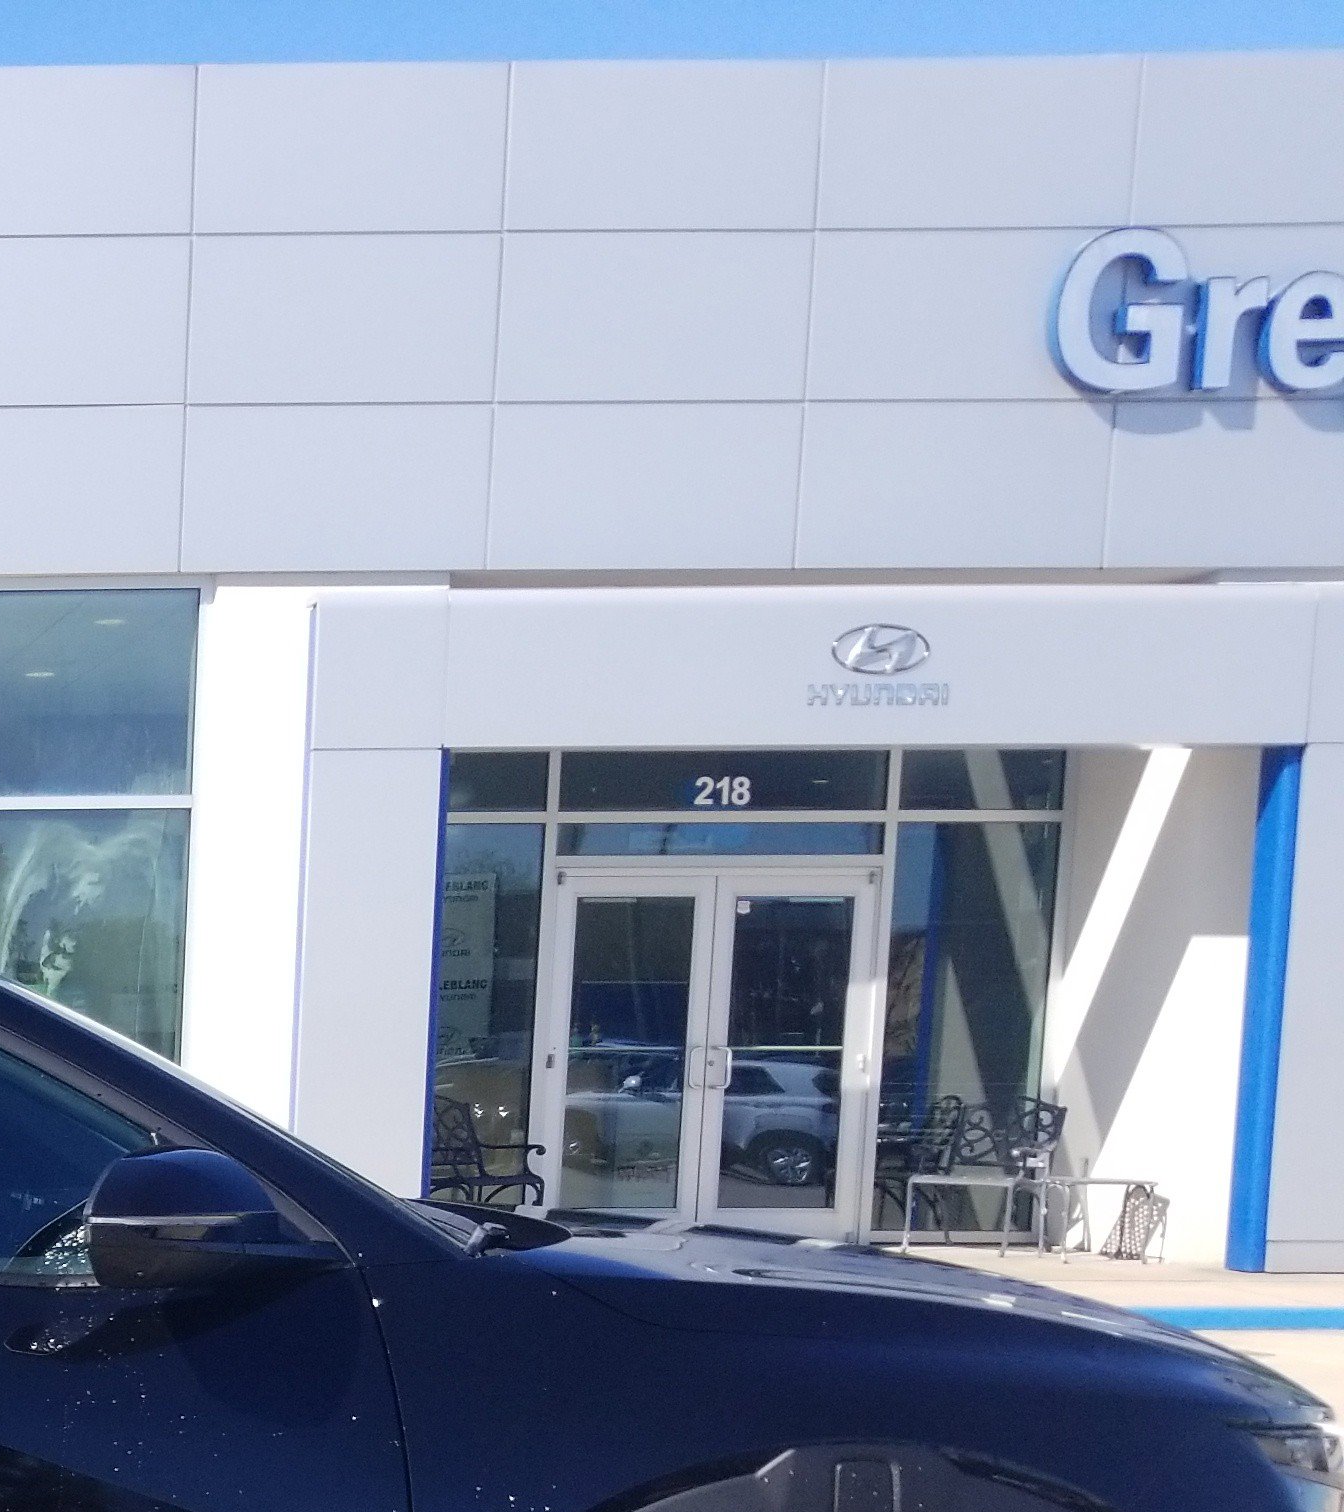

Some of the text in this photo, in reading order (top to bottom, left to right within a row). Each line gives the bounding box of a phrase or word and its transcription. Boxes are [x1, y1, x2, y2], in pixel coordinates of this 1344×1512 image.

[806, 683, 950, 706] HYUNDAI
[693, 776, 751, 806] 218
[445, 879, 489, 891] EBLANC
[439, 979, 488, 990] EBLANC
